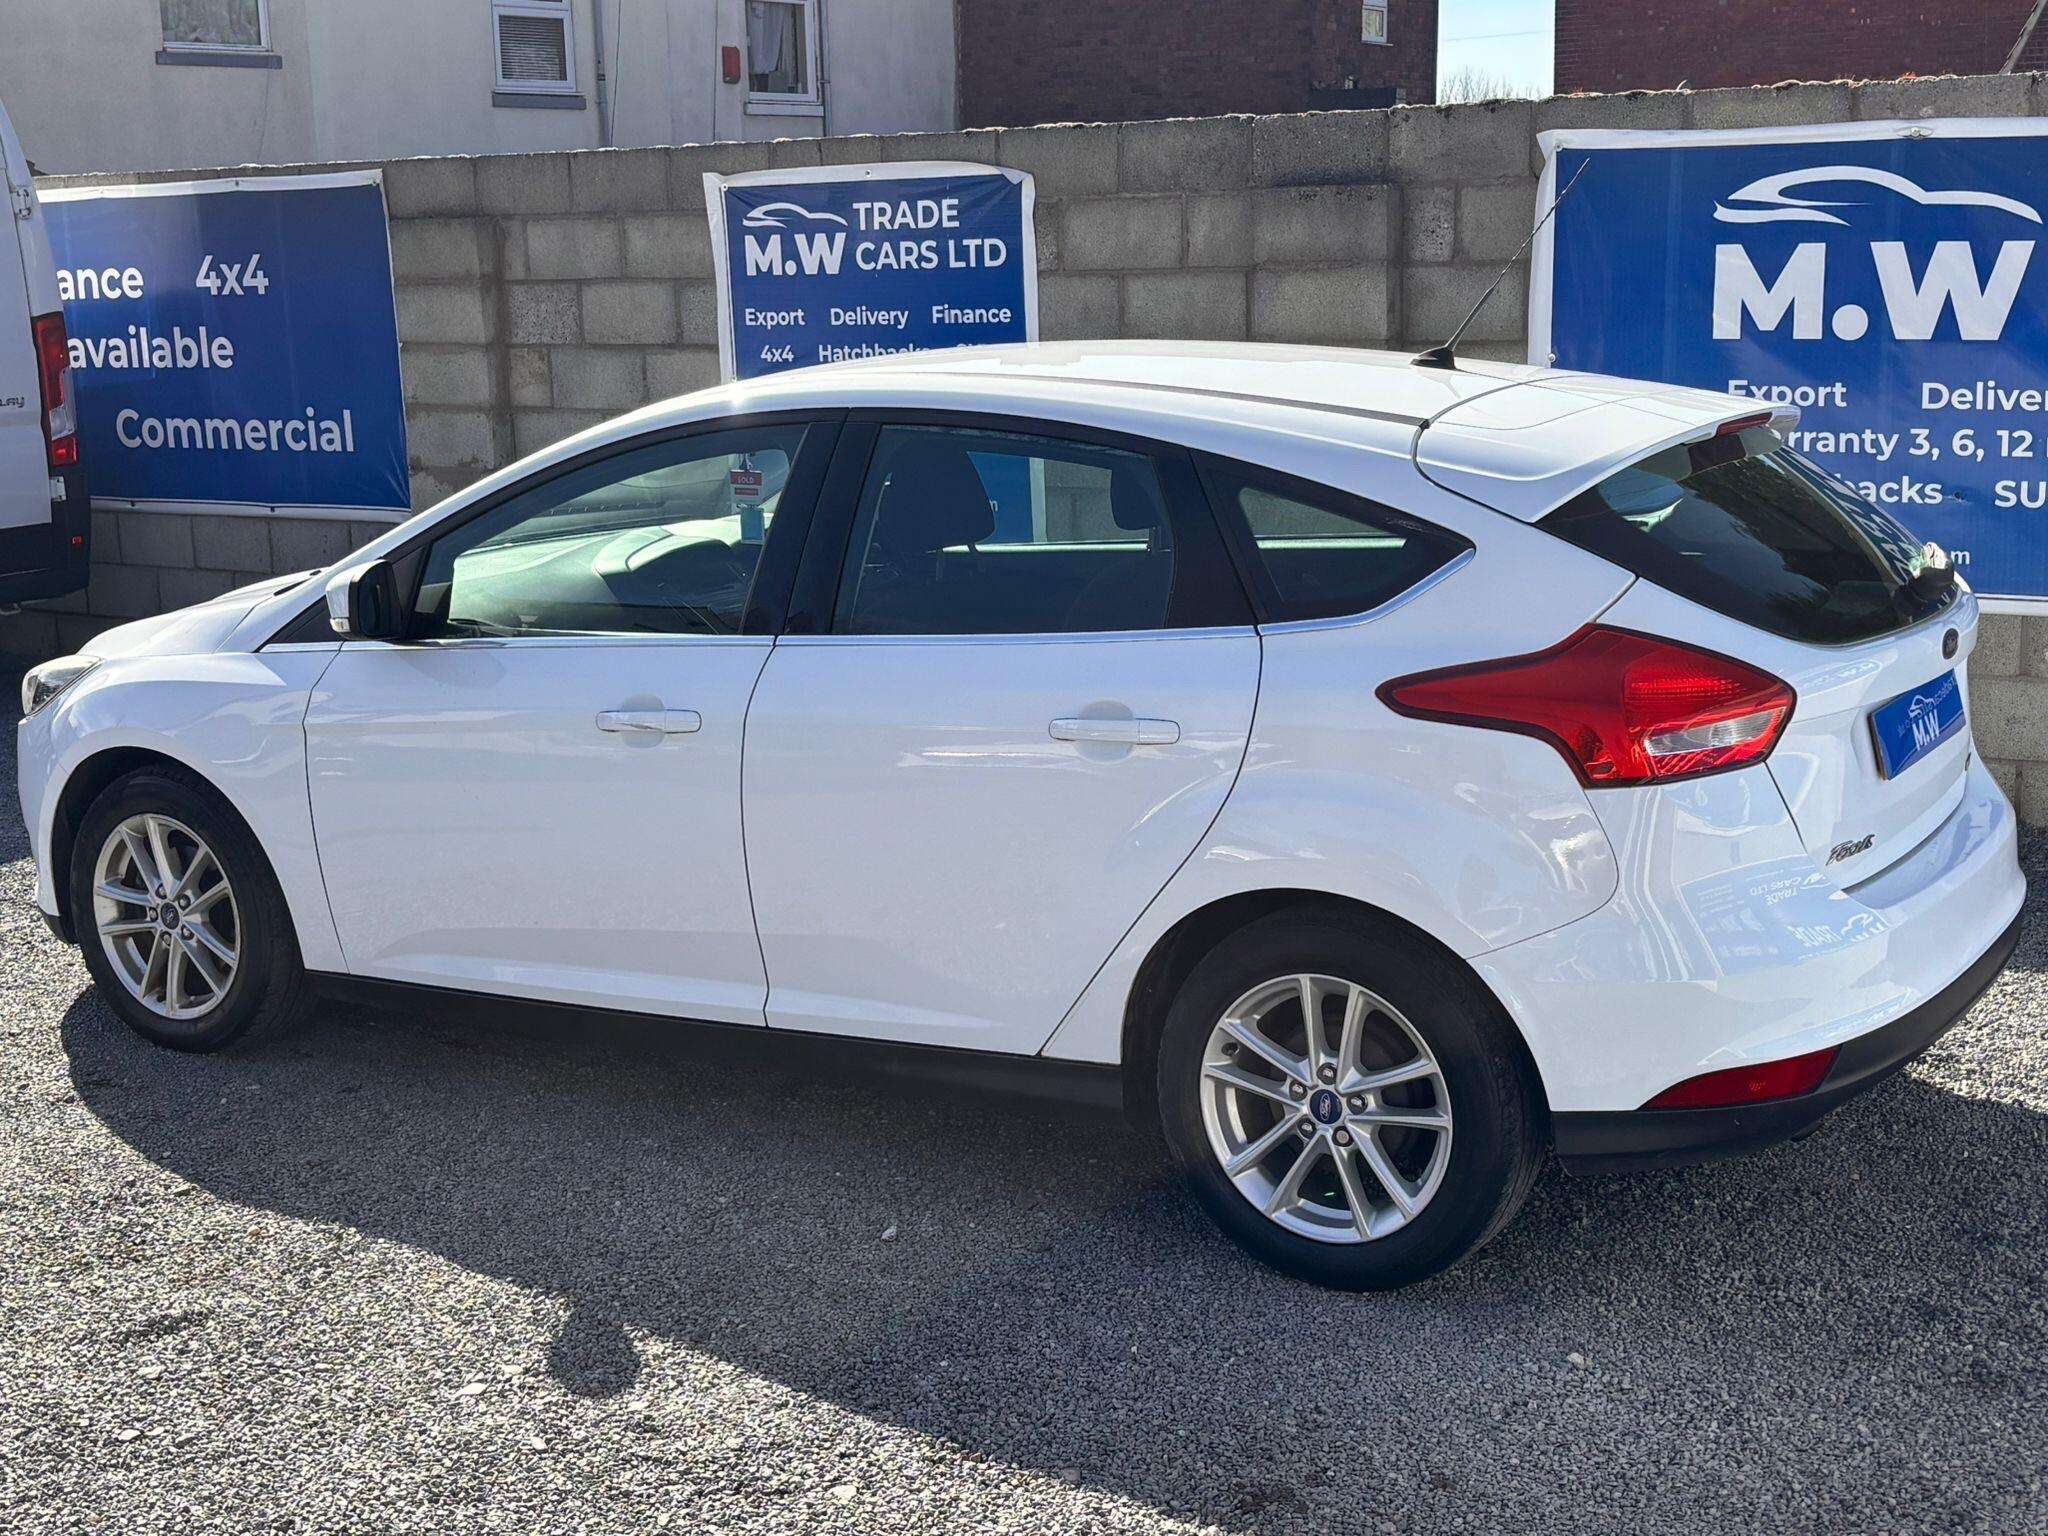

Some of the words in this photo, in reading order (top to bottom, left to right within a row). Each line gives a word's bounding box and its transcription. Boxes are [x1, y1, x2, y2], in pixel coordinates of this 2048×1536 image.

[852, 198, 960, 231] TRADE
[744, 232, 847, 276] M.W
[855, 241, 939, 271] CARS
[948, 237, 1008, 269] LTD
[56, 267, 144, 300] ance
[195, 253, 269, 296] 4x4
[1712, 239, 2036, 342] M.W
[745, 307, 806, 330] Export
[830, 305, 909, 330] Delivery
[931, 303, 1012, 325] Finance
[67, 324, 235, 369] available
[760, 344, 795, 362] 4x4
[1728, 379, 1848, 408] Export
[1921, 380, 2048, 412] Delive
[115, 407, 354, 453] Commercial
[1909, 428, 1941, 461] 3,
[1952, 429, 1985, 462] 6,
[1996, 429, 2034, 458] 12
[1995, 480, 2047, 509] SU
[1912, 708, 1941, 751] M.W
